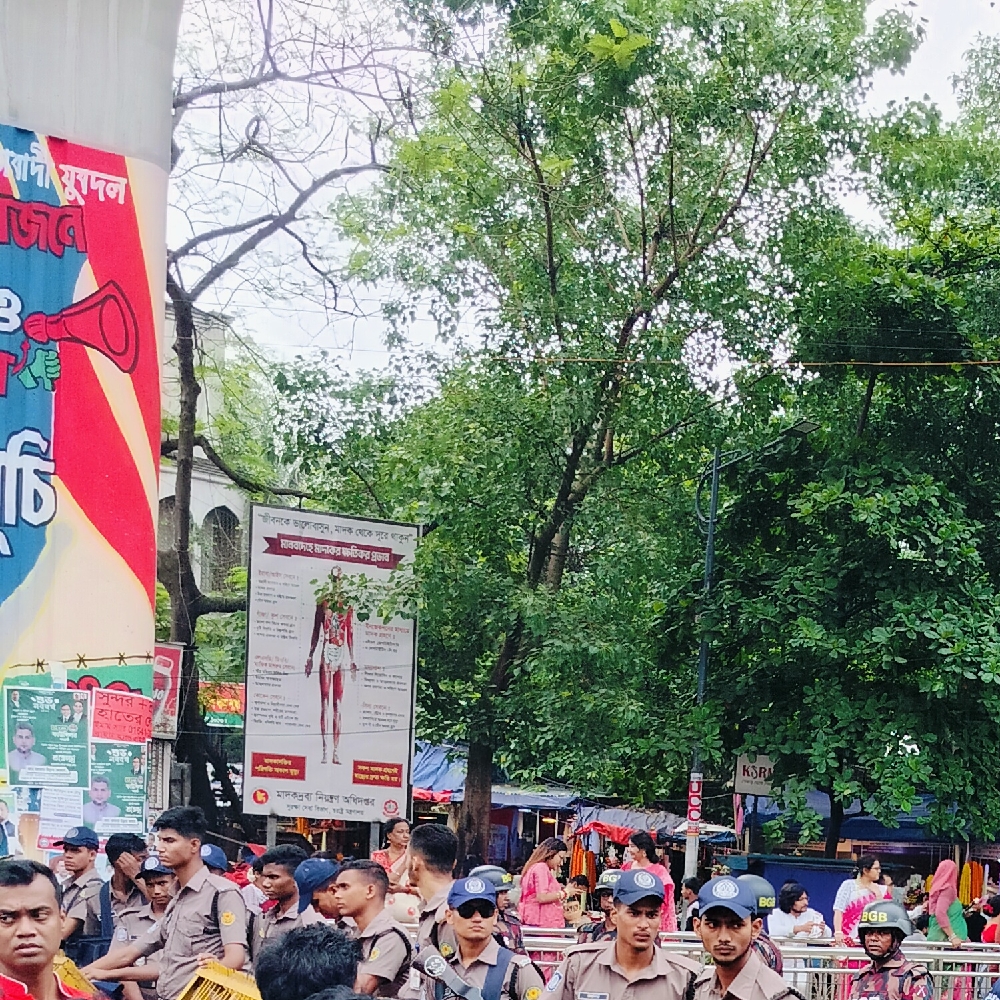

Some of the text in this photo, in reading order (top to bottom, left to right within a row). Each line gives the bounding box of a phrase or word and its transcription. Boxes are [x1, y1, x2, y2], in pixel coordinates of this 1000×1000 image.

[59, 164, 127, 206] যুবদল
[602, 874, 621, 884] BG
[861, 910, 888, 922] BGB
